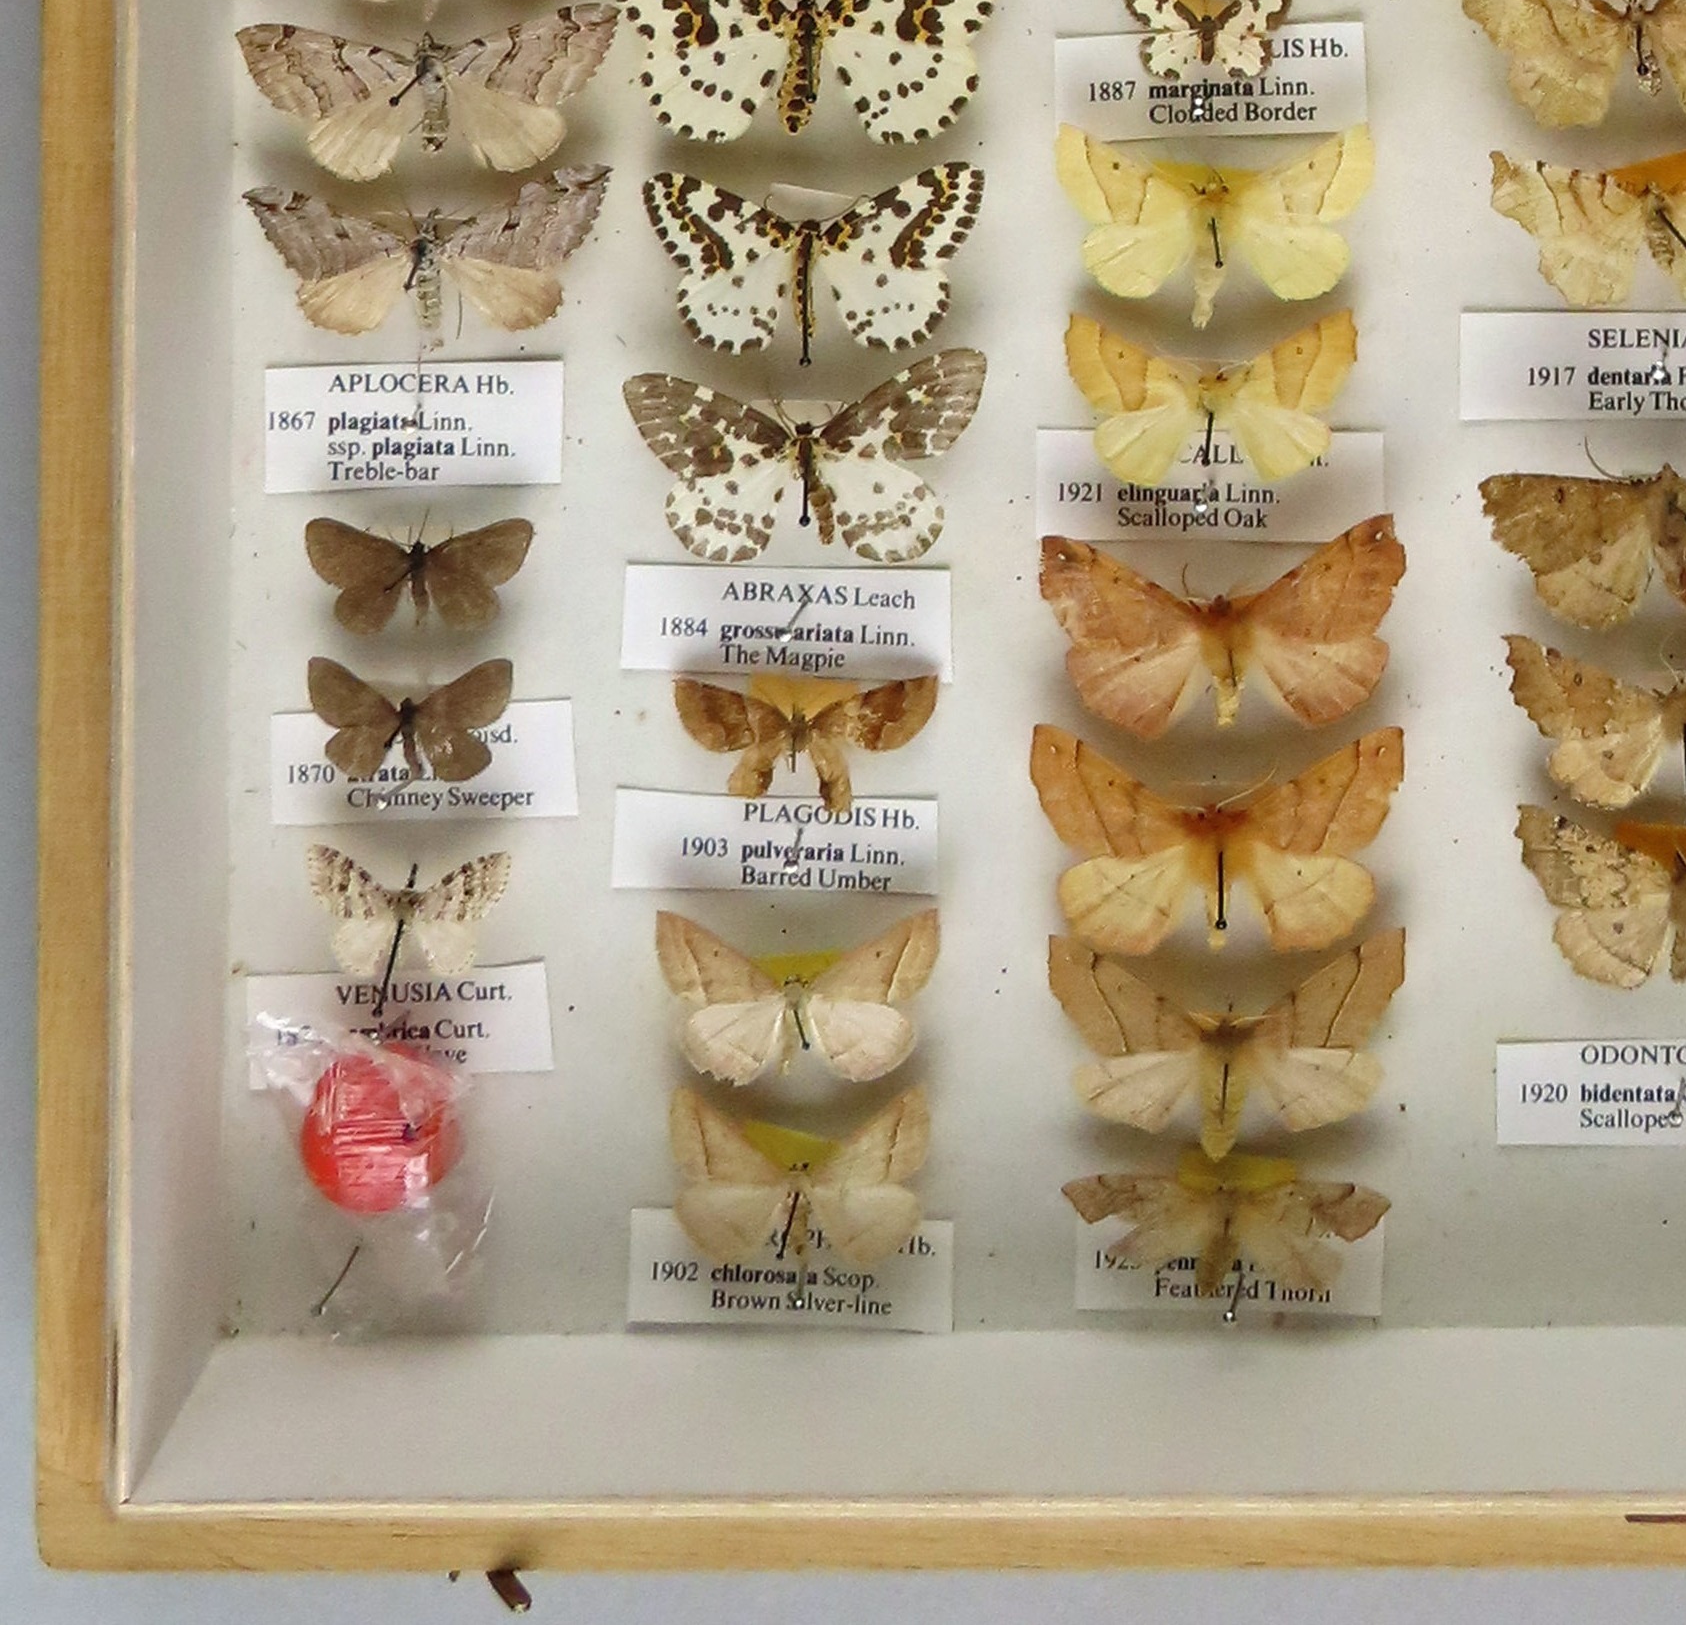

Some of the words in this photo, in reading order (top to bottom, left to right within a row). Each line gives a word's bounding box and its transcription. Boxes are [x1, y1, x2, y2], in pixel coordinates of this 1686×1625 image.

[1090, 81, 1136, 102] 1887
[1255, 72, 1314, 96] Linn.
[1244, 101, 1317, 122] Border
[329, 370, 469, 393] APLOCERA
[477, 375, 513, 394] Hb.
[1529, 366, 1576, 386] 1917
[1589, 391, 1645, 416] Early
[269, 411, 315, 431] 1867
[415, 409, 472, 431] Linn.
[372, 437, 455, 465] plagiata
[461, 437, 515, 457] Linn.
[328, 457, 440, 481] Treble-bar
[1059, 482, 1105, 503] 1921
[1226, 483, 1280, 504] Linn.
[1118, 502, 1218, 532] Scalloped
[1224, 508, 1268, 528] Oak
[722, 582, 847, 610] ABRAXAS
[854, 587, 915, 609] Leach
[661, 617, 708, 637] 1884
[860, 625, 914, 646] Linn.
[720, 644, 760, 665] The
[765, 646, 845, 674] Magpie
[445, 786, 533, 813] Sweeper
[682, 837, 728, 858] 1903
[850, 844, 905, 866] Linn.
[819, 868, 894, 896] Umber
[1522, 1083, 1568, 1103] 1920
[1581, 1084, 1678, 1108] bidentata
[653, 1257, 703, 1282] 1902
[711, 1289, 780, 1310] Brown
